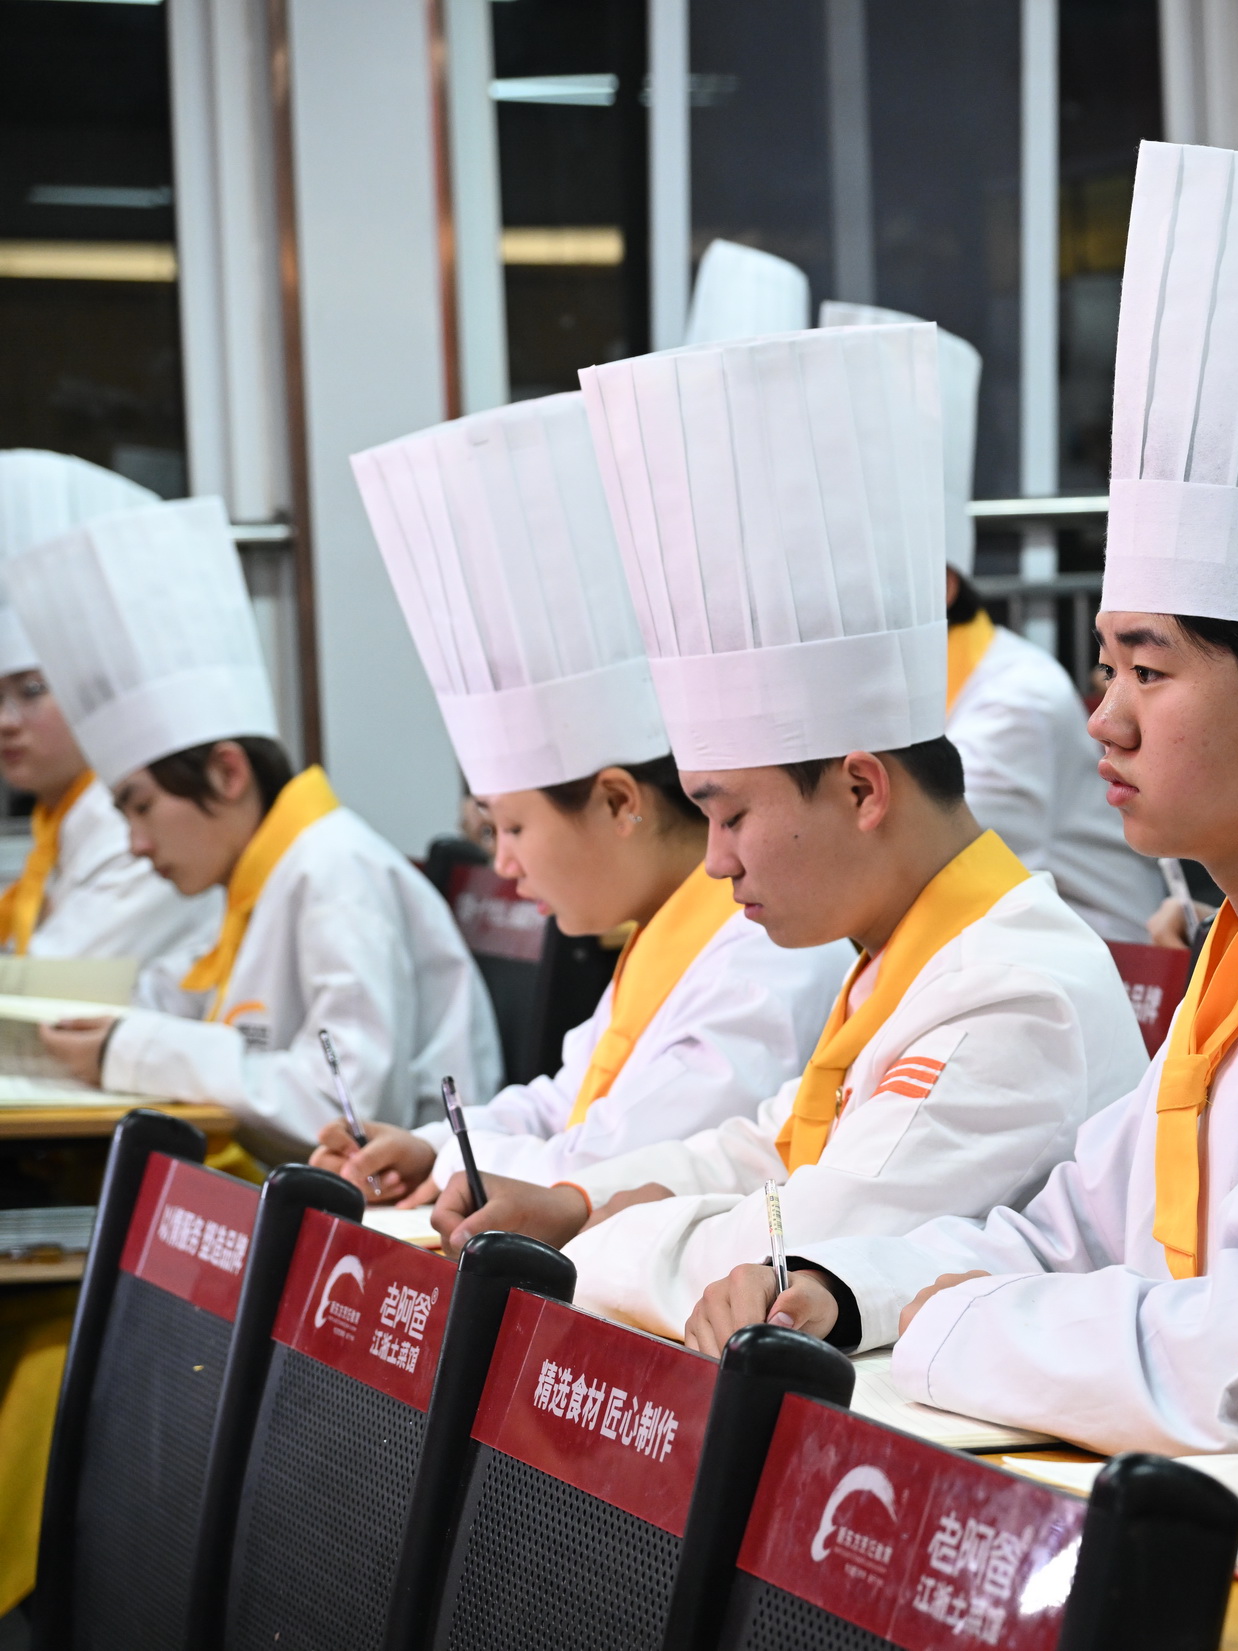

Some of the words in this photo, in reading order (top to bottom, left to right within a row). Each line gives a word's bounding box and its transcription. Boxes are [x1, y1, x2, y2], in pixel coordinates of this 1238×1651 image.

[1124, 981, 1163, 1024] 品牌
[379, 1281, 432, 1341] 老阿爸
[369, 1328, 420, 1374] 江浙土菜馆
[533, 1358, 607, 1431] 精选食材
[600, 1386, 680, 1463] 匠心制作
[927, 1510, 1022, 1600] 老阿爸
